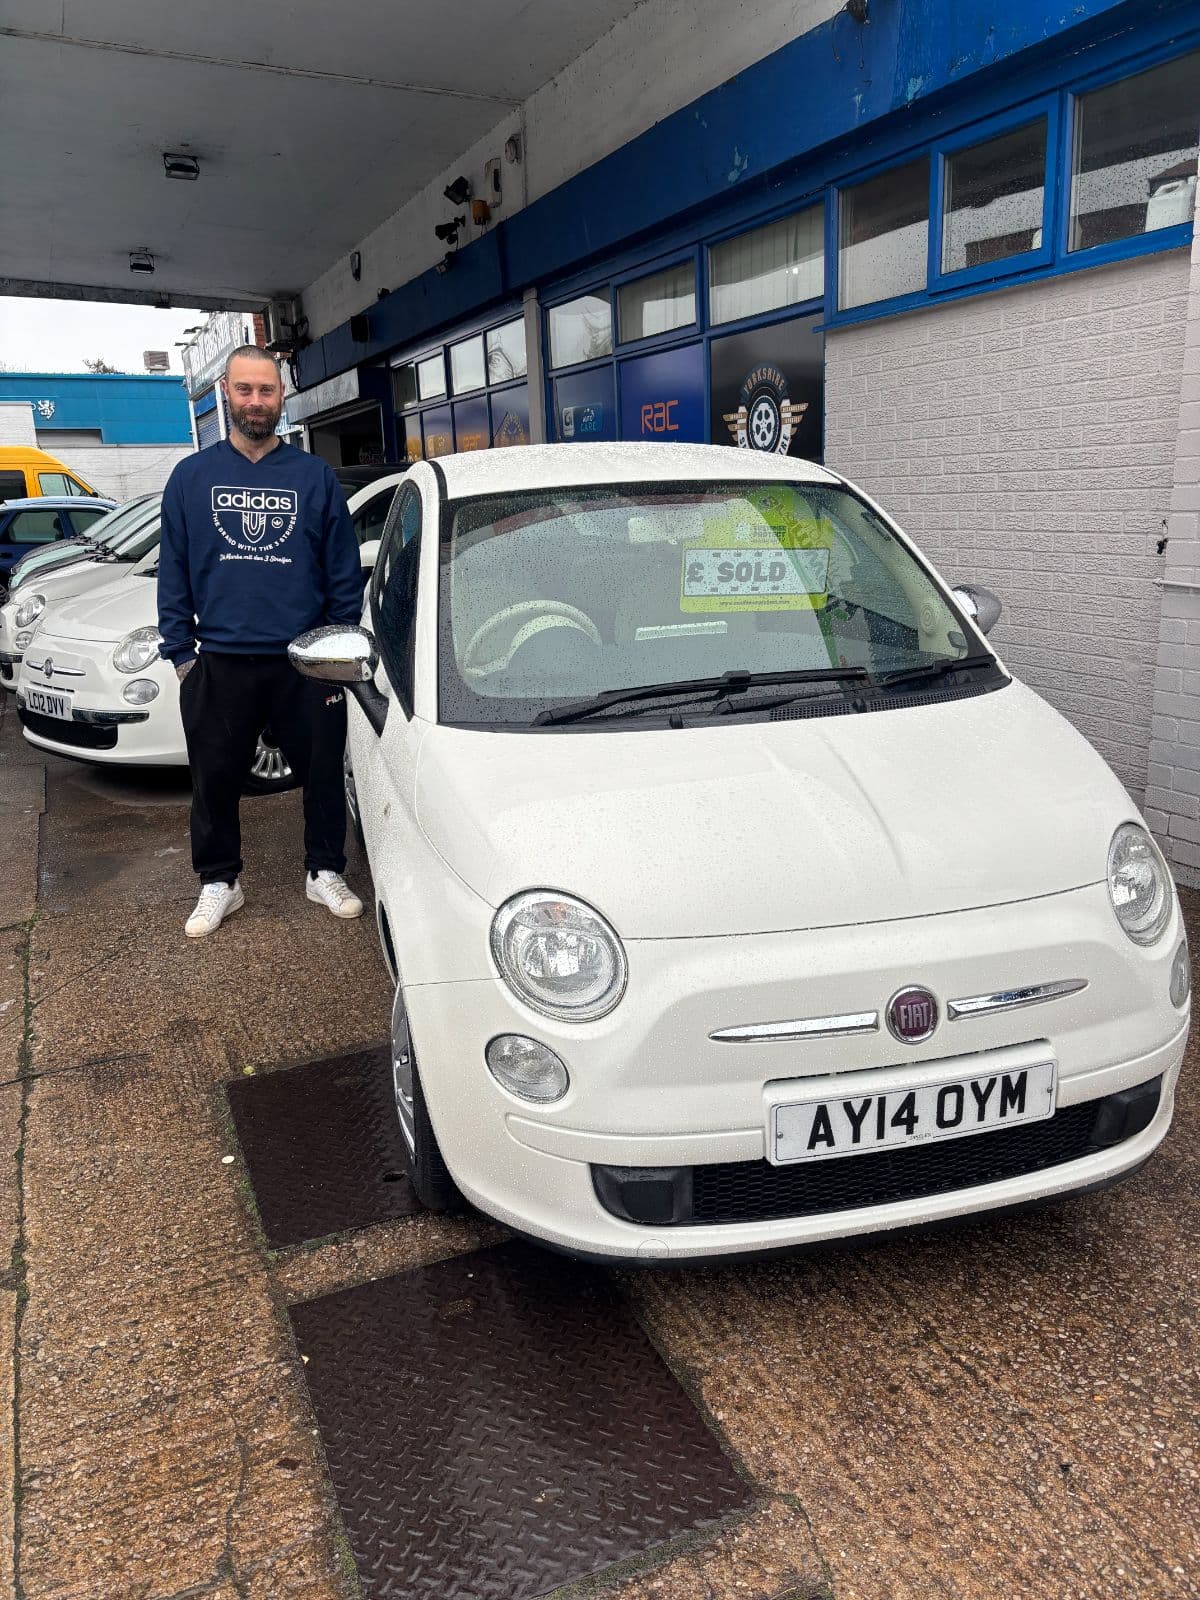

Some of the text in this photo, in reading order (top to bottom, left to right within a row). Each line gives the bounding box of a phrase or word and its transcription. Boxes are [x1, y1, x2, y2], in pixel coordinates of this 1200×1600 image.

[743, 367, 785, 394] YORKSHIRE
[217, 491, 292, 510] adidas
[212, 511, 220, 527] THE
[218, 527, 236, 546] BRAND
[237, 543, 257, 552] WITH
[258, 543, 274, 552] THE
[279, 516, 297, 543] STRIPES
[717, 561, 787, 583] SOLD
[28, 690, 64, 716] LC12 DVV
[325, 693, 343, 705] FILA
[900, 1002, 928, 1029] FIAT
[806, 1070, 1029, 1150] AY14 OYM
